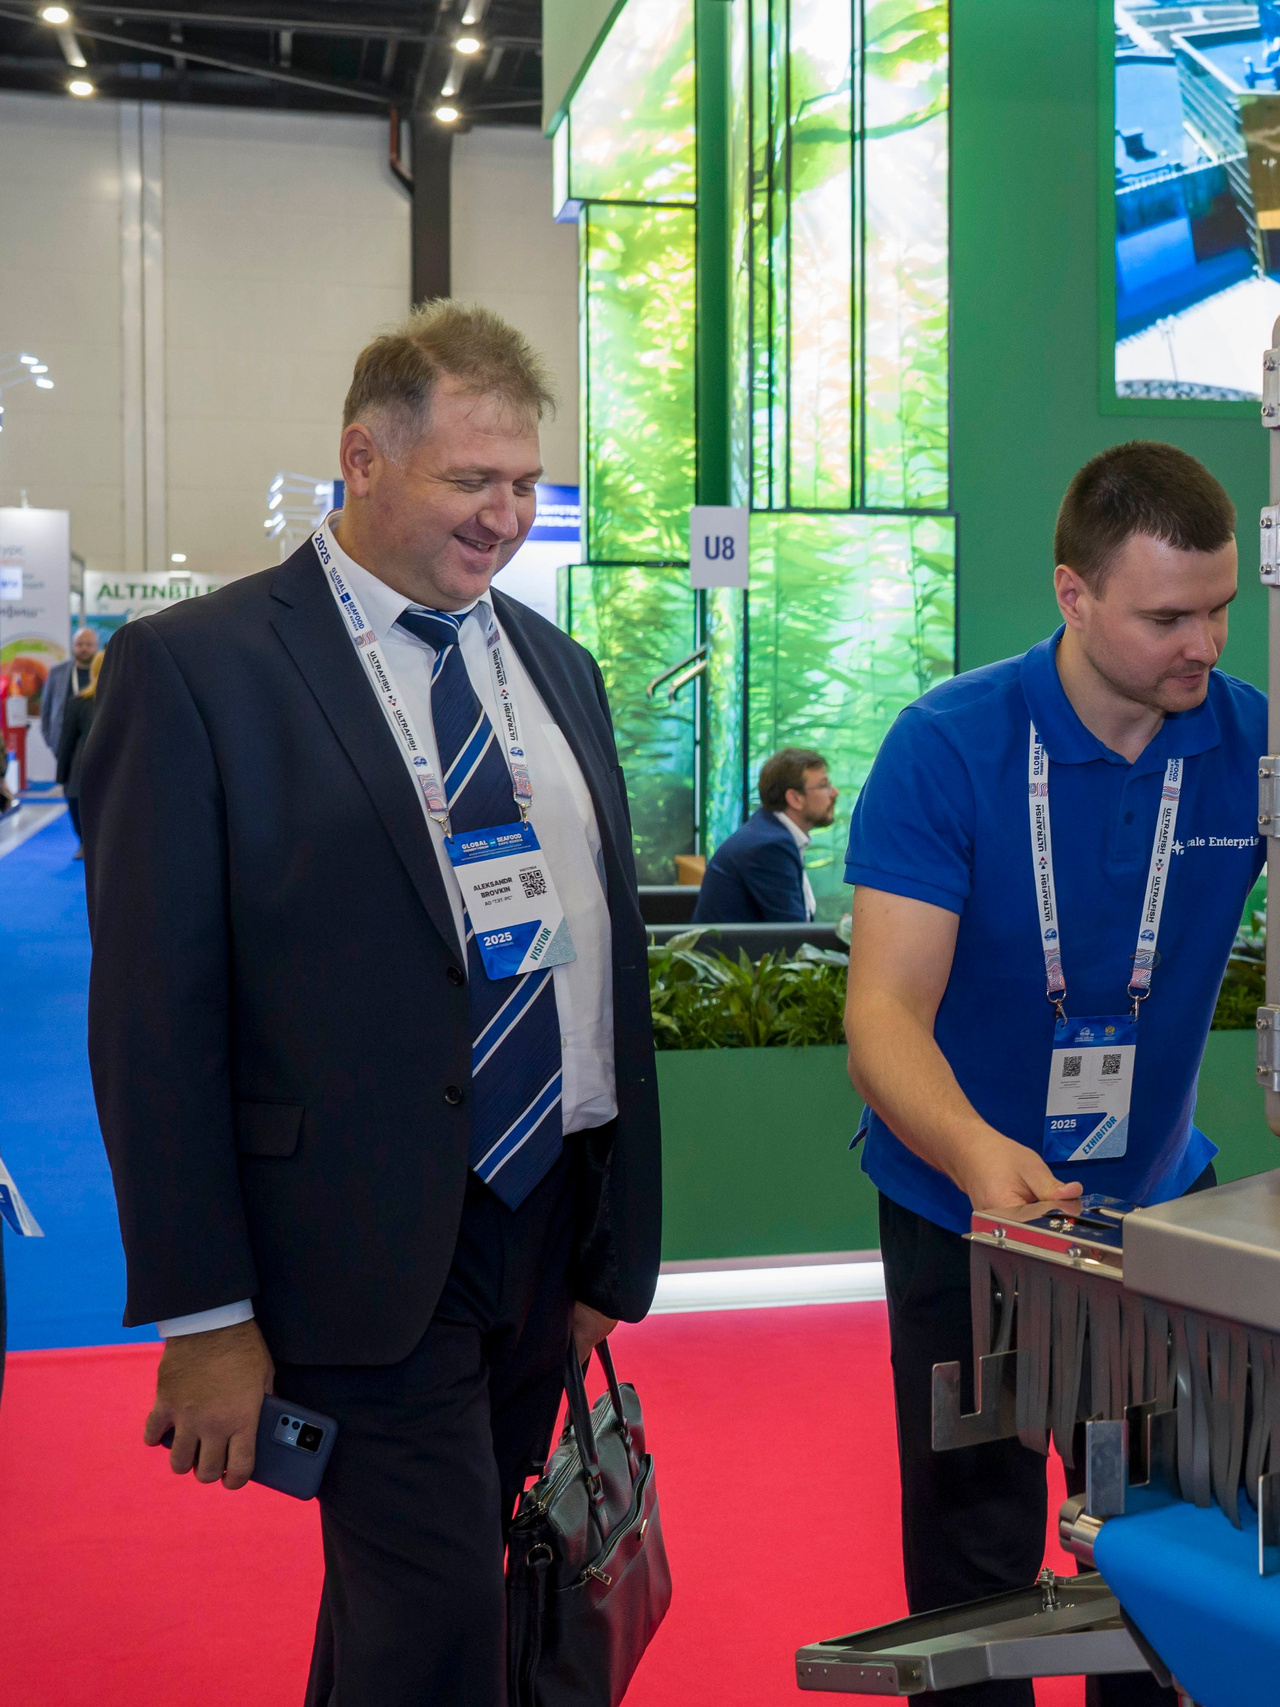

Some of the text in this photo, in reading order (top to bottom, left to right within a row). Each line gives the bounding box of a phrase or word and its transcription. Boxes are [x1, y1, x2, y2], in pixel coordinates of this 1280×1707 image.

[314, 533, 331, 565] 2025
[704, 535, 735, 560] U8
[331, 567, 346, 593] GLOBAL
[348, 601, 365, 629] SEAFOOD
[370, 651, 391, 691] ULTRAFISH
[492, 649, 505, 686] ULTRAFISH
[395, 709, 417, 751] ULTRAFISH
[503, 703, 516, 741] ULTRAFISH
[1033, 745, 1041, 776] GLOBAL
[461, 840, 488, 850] GLOBAL
[496, 833, 523, 843] SEAFOOD
[1035, 804, 1044, 852] ULTRAFISH
[1160, 808, 1171, 854] ULTRAFISH
[473, 877, 513, 891] ALEKSANDR
[480, 886, 511, 898] BROVKIN
[1041, 873, 1051, 922] ULTRAFISH
[1149, 876, 1161, 923] ULTRAFISH
[483, 931, 513, 946] 2025
[529, 927, 552, 961] VISITOR
[1050, 1119, 1077, 1130] 2025
[1082, 1115, 1117, 1155] EXHIBITOR
